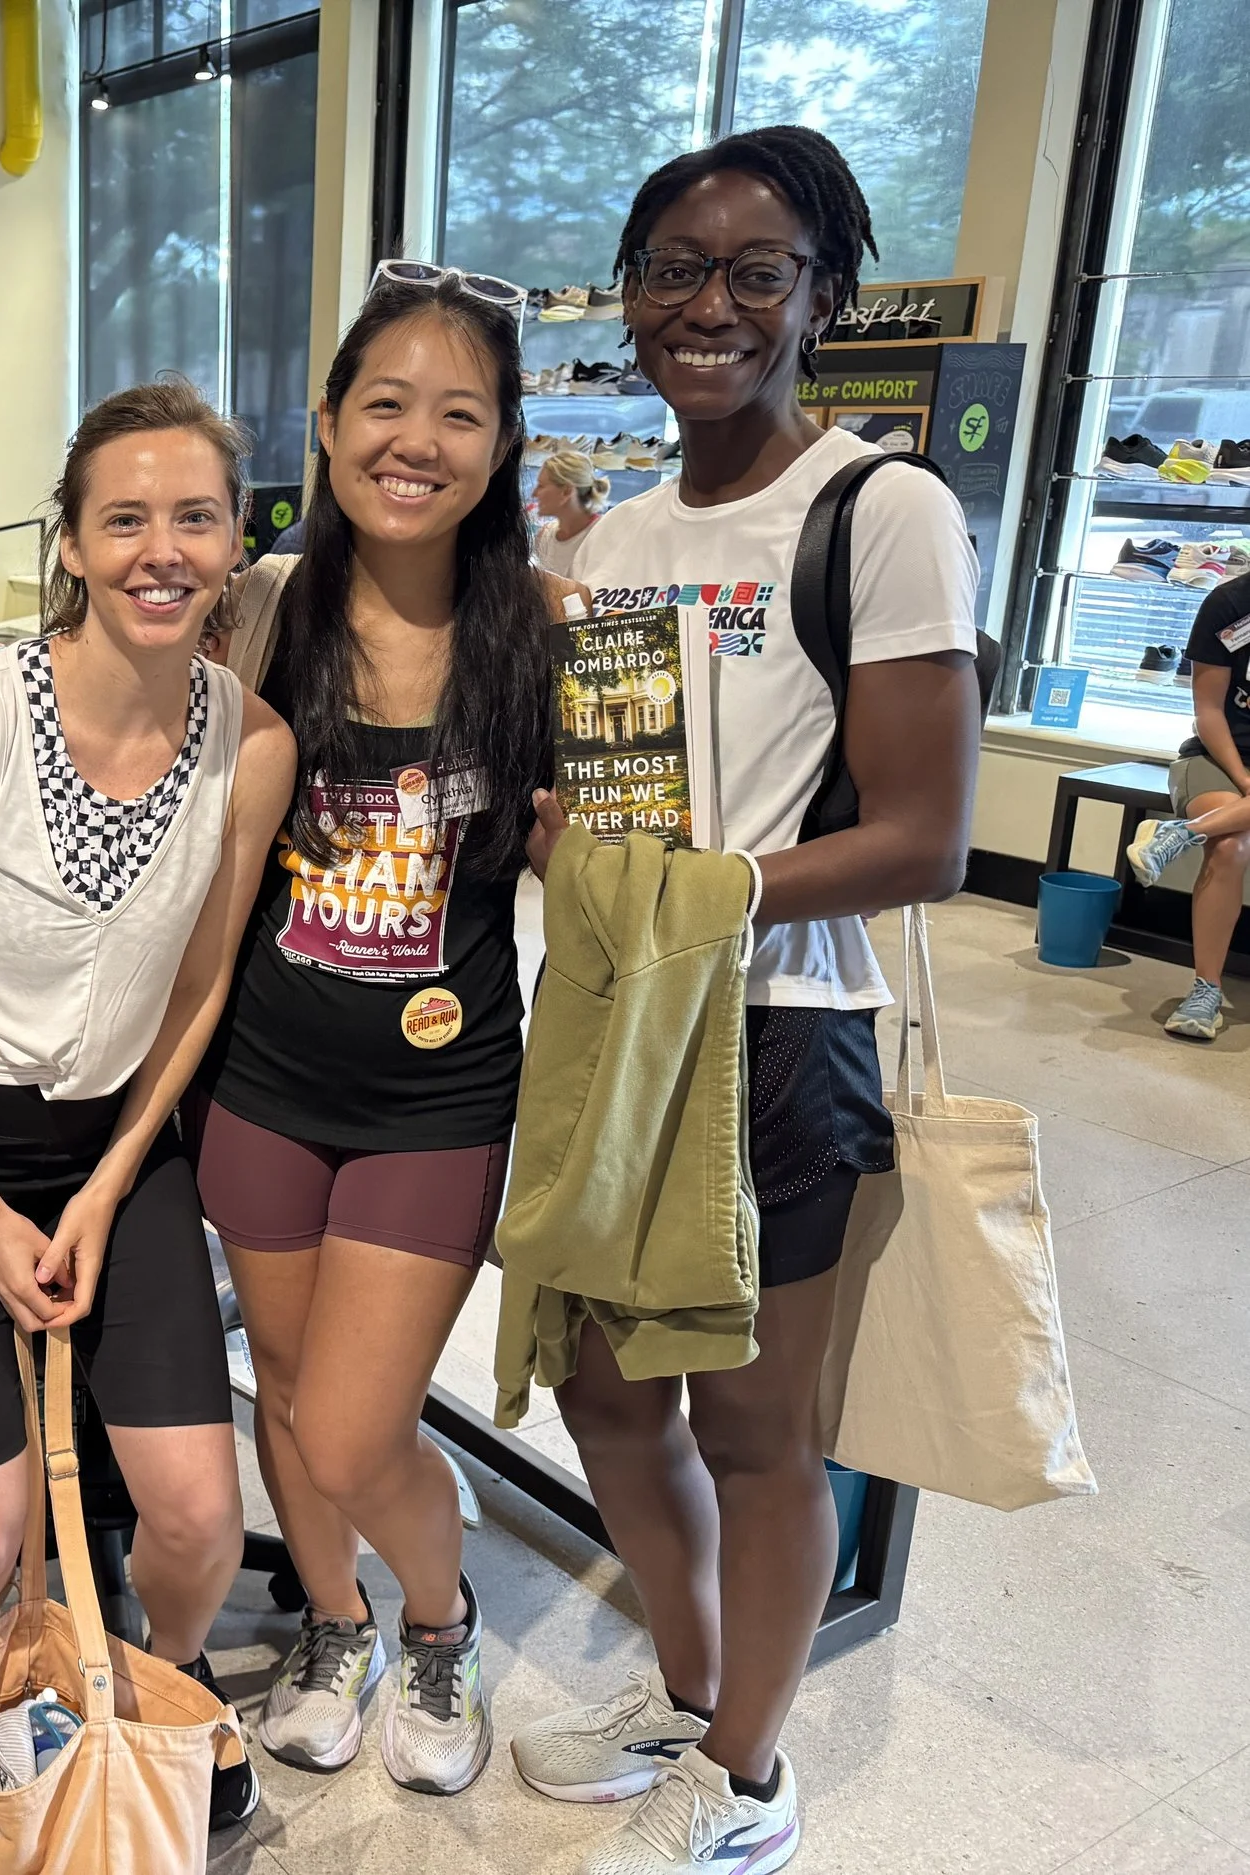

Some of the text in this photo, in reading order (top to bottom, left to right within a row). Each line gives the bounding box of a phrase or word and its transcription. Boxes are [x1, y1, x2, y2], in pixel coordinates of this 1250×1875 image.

[842, 380, 918, 400] COMFORT
[592, 588, 641, 610] 2025
[569, 615, 657, 633] NEW YORK TIMES BESTSELLER
[709, 607, 766, 630] ERICA
[582, 630, 645, 651] CLAIRE
[565, 650, 665, 675] LOMBARDO
[564, 755, 677, 780] THE MOST
[356, 793, 395, 805] BOOK
[421, 785, 473, 805] Cynthia
[579, 783, 665, 805] FUN WE
[568, 809, 679, 830] EVER HAD
[300, 883, 432, 938] YOURS
[281, 948, 312, 965] CHICAGO
[391, 944, 429, 956] World
[406, 1016, 430, 1035] READ
[431, 1016, 438, 1024] &
[440, 1008, 458, 1026] RUN
[631, 1741, 660, 1752] BROOKS
[703, 1838, 726, 1858] BROKS
